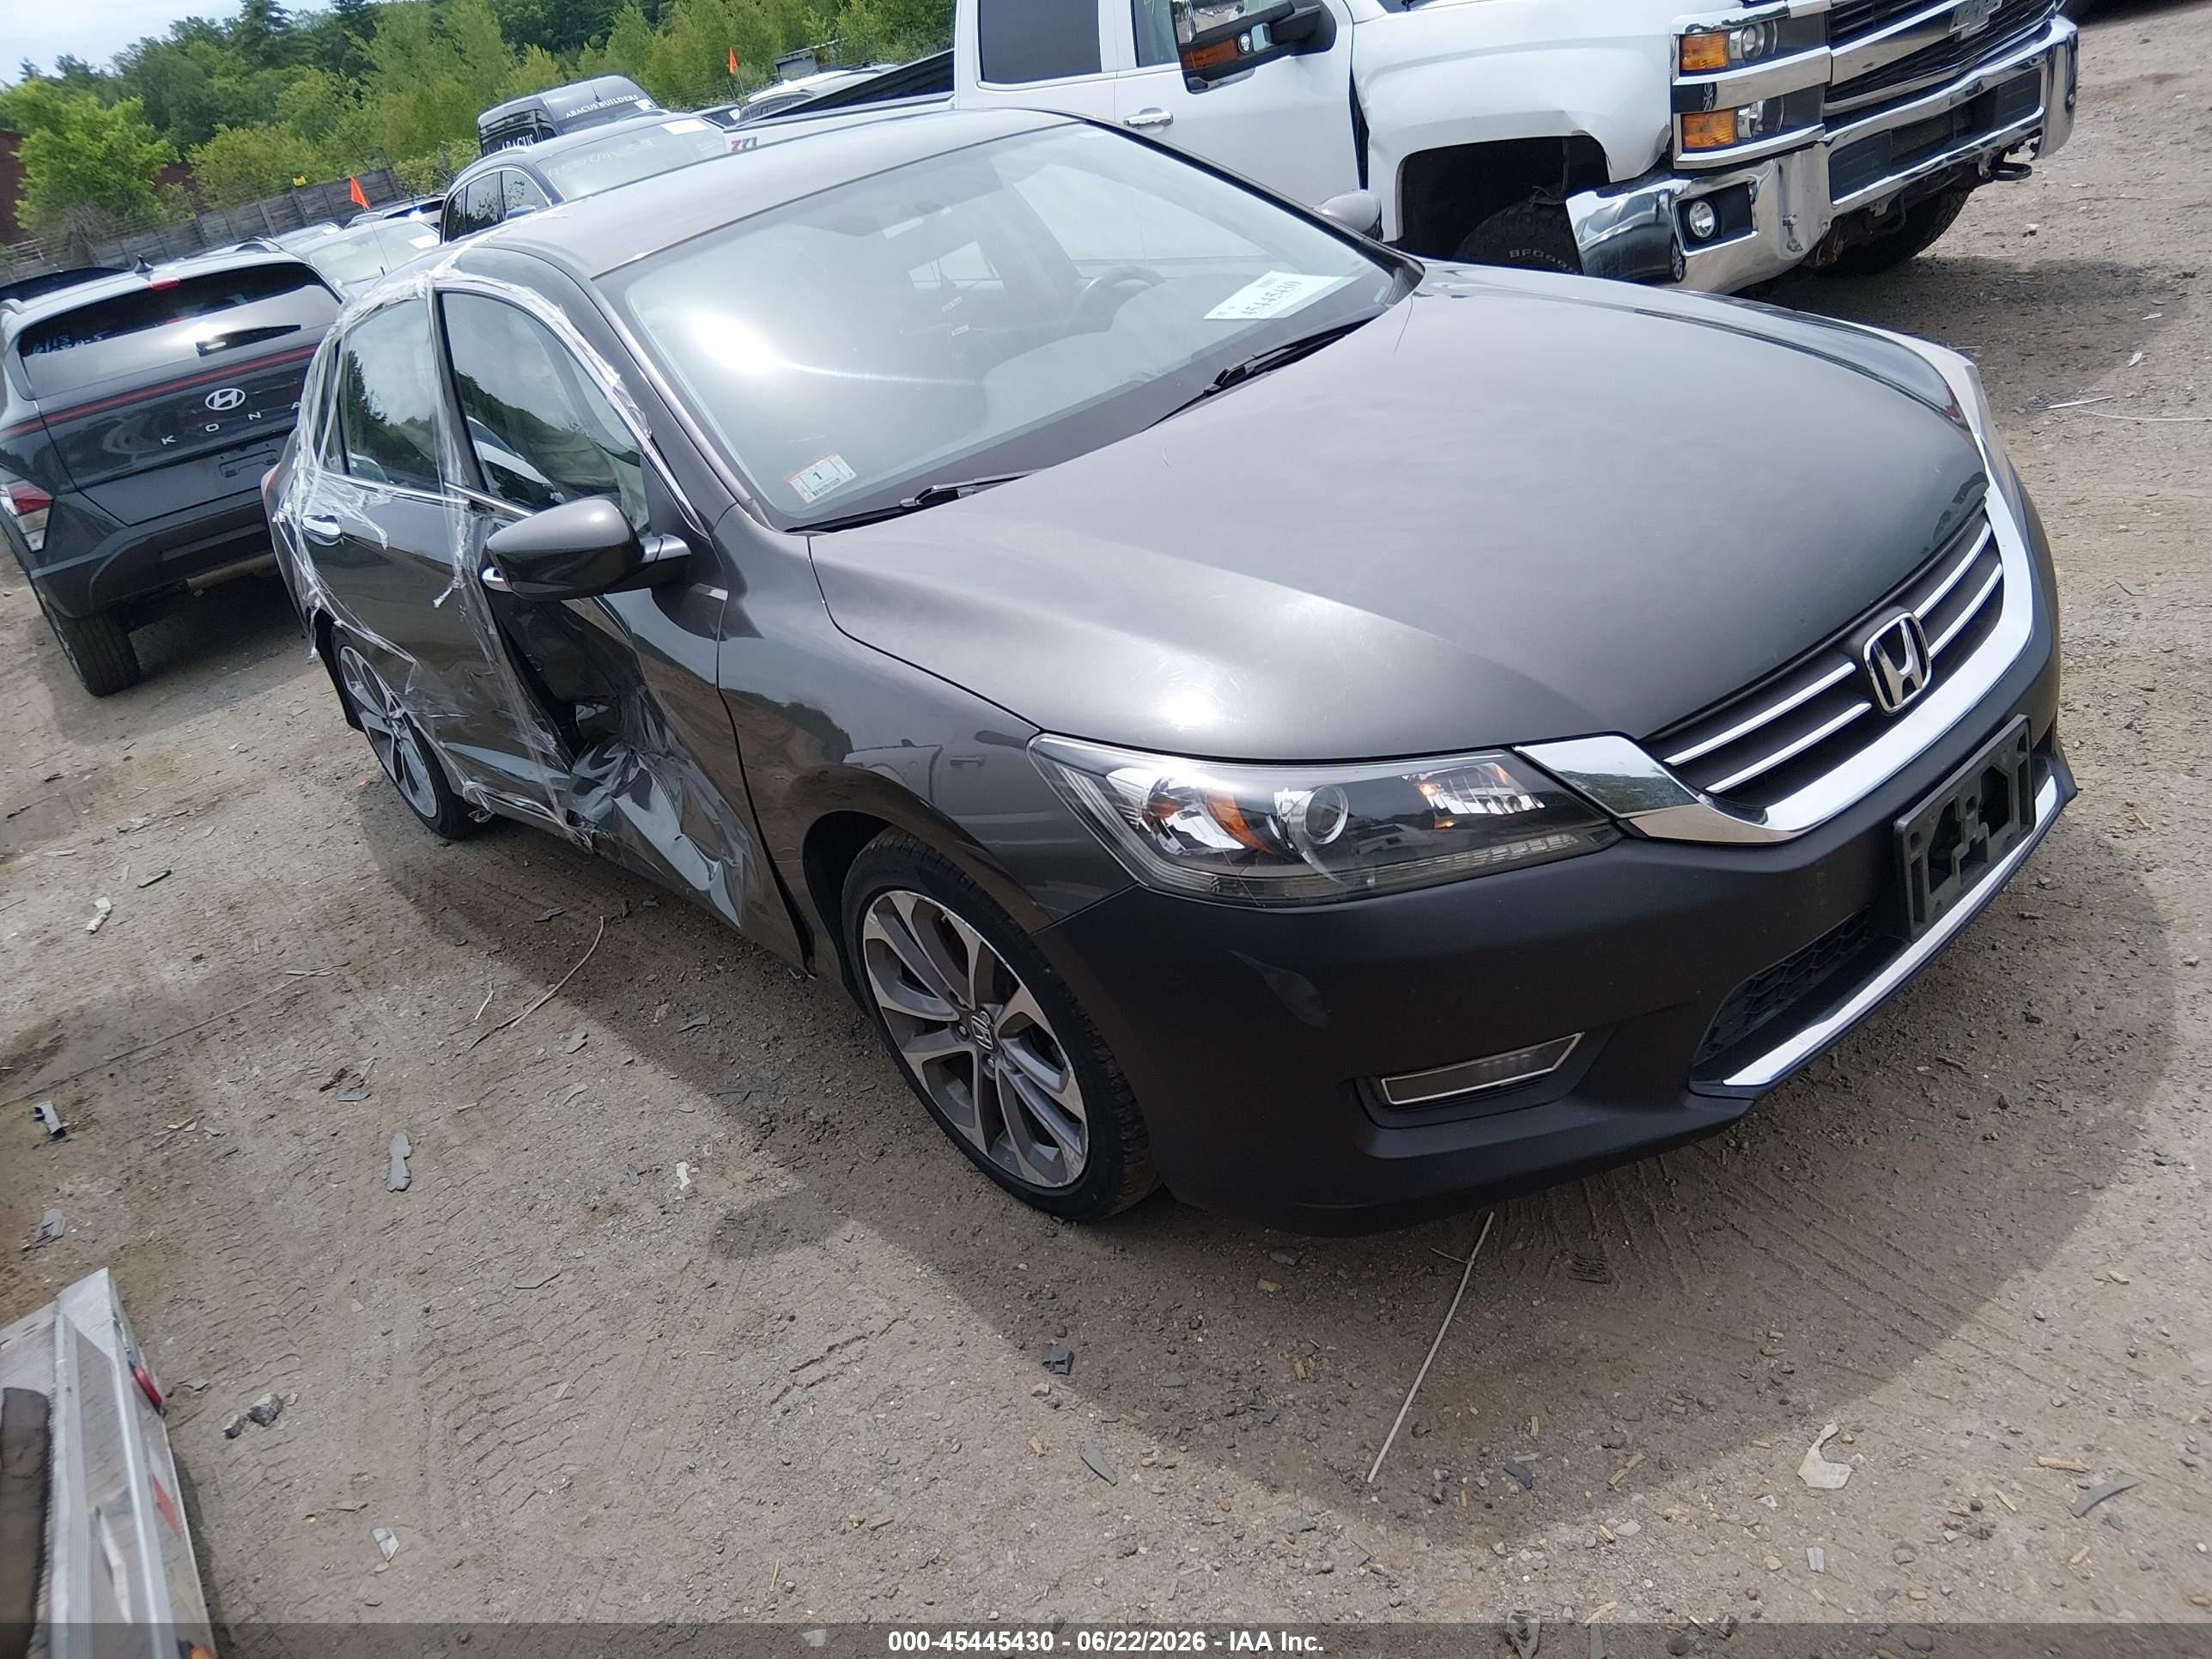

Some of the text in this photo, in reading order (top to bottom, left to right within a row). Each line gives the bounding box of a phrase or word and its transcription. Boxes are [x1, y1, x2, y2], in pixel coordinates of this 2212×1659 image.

[565, 94, 639, 119] ABACUS BUILDERS
[161, 401, 301, 446] KONA
